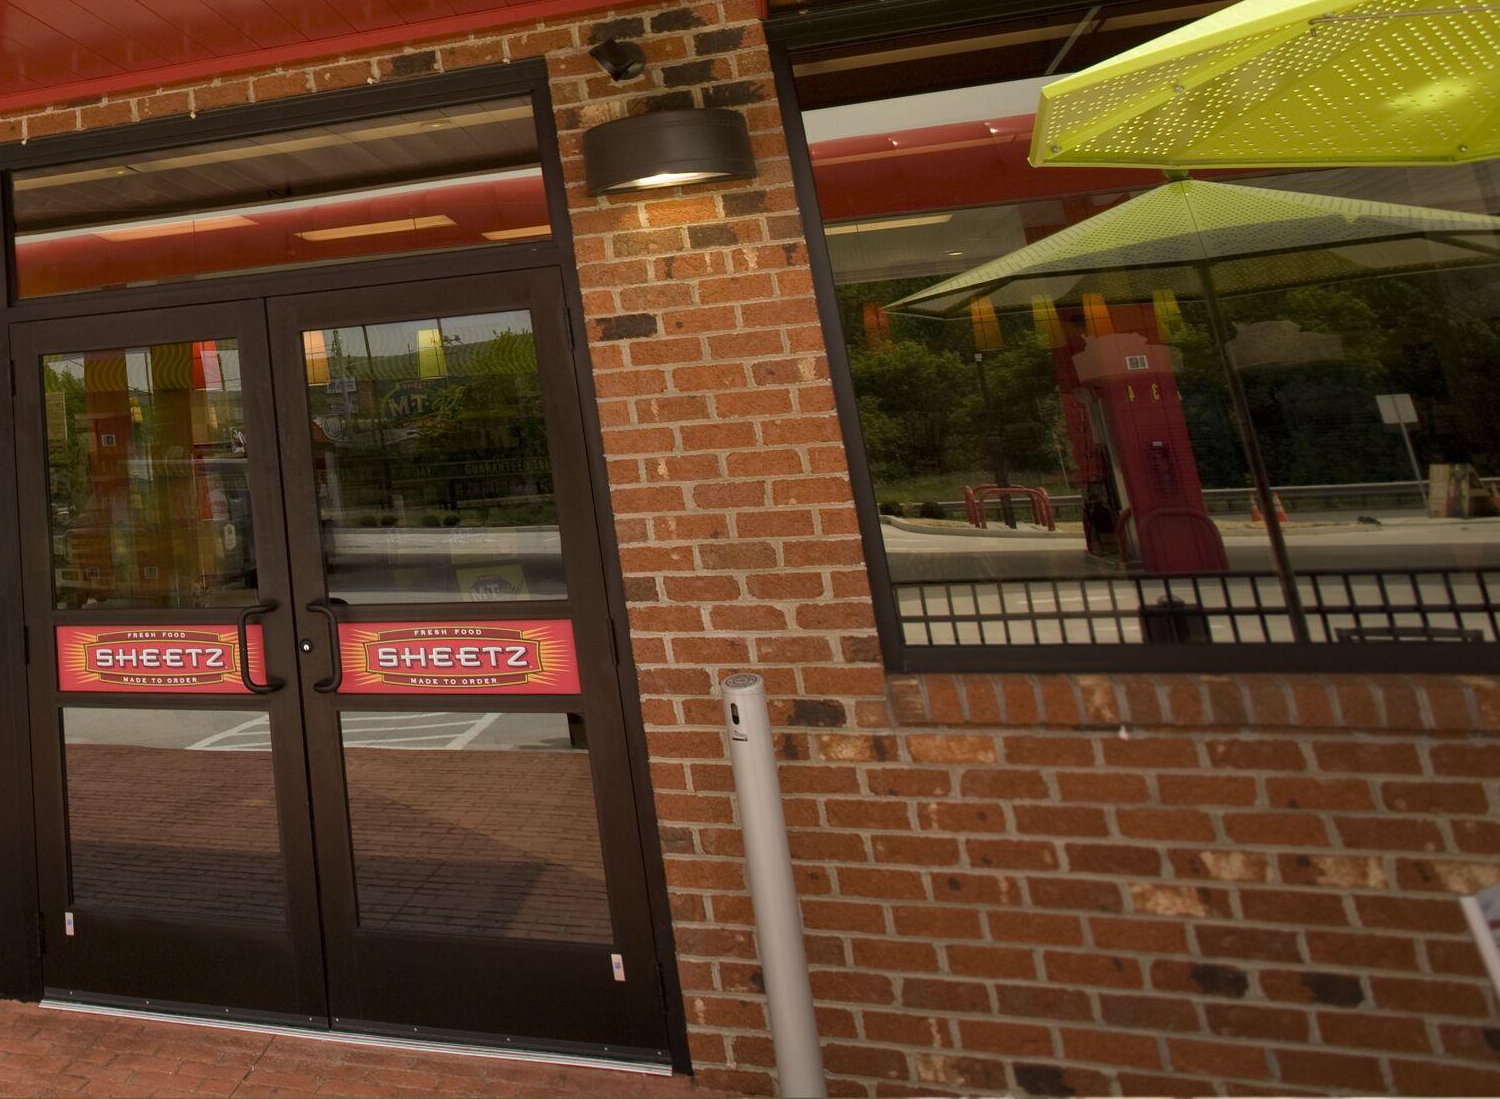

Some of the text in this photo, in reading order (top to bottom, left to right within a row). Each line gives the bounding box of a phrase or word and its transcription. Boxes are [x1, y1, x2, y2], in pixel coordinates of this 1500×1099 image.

[454, 628, 482, 636] FOOD
[96, 648, 224, 667] SHEETZ
[378, 646, 528, 667] SHEETZ
[410, 677, 438, 685] MADE
[461, 677, 497, 685] ORDER
